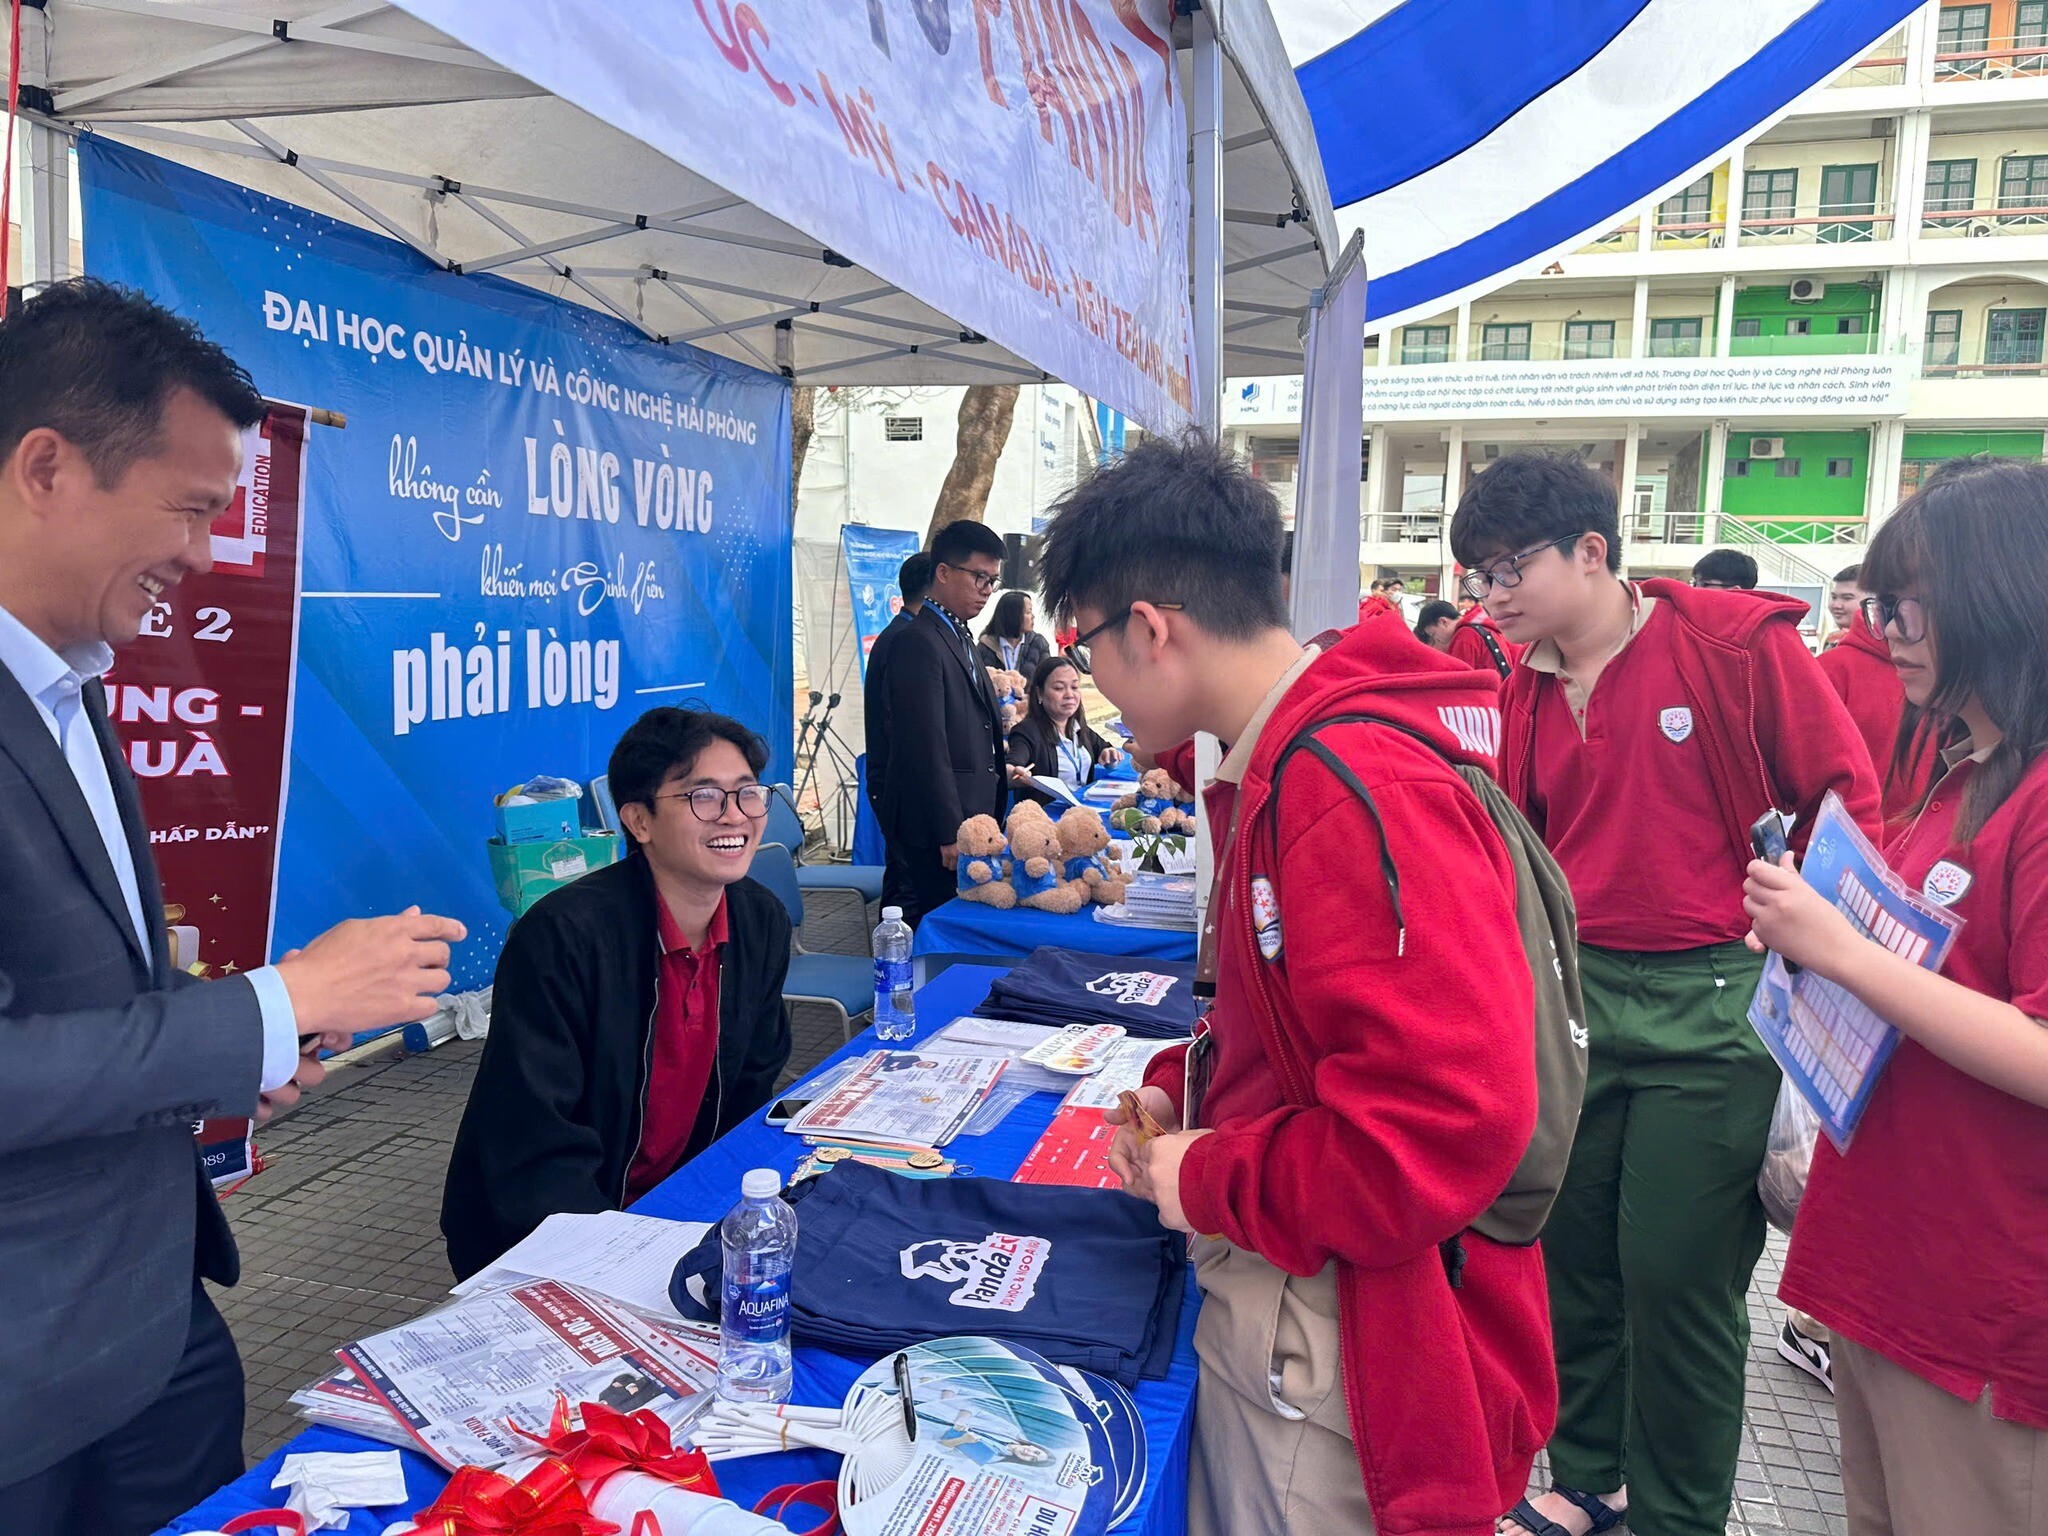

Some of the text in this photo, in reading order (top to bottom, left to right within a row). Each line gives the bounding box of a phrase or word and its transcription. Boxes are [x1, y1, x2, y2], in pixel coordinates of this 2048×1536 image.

[816, 68, 906, 194] MỸ
[927, 160, 1061, 308] CANADA
[1069, 265, 1111, 345] NEW
[1111, 304, 1163, 388] ZEALAND
[263, 290, 757, 445] ĐẠI HỌC QUẢN LÝ VÀ CÔNG NGHỆ HẢI PHÒNG
[1380, 377, 1389, 385] và
[1391, 377, 1409, 386] sáng
[1428, 375, 1443, 383] kiến
[1445, 375, 1462, 383] thức
[1502, 373, 1517, 381] tính
[1519, 373, 1539, 381] nhân
[1558, 372, 1568, 380] và
[1592, 371, 1618, 379] nhiệm
[1662, 369, 1690, 378] Trường
[1693, 369, 1708, 377] Đại
[1710, 369, 1725, 377] học
[1727, 369, 1751, 377] Quản
[1775, 368, 1797, 377] Công
[1799, 368, 1821, 377] nghệ
[1824, 367, 1839, 375] Hải
[1841, 367, 1870, 376] Phòng
[1872, 366, 1892, 374] luôn
[1378, 402, 1398, 410] năng
[1400, 402, 1410, 410] lực
[1428, 401, 1450, 409] người
[1452, 401, 1471, 409] công
[1528, 398, 1545, 406] hiểu
[1547, 398, 1556, 406] rõ
[1557, 398, 1573, 406] bản
[1615, 397, 1630, 405] chủ
[1644, 397, 1654, 405] sử
[1656, 397, 1677, 405] dụng
[1680, 397, 1700, 405] sáng
[1703, 396, 1717, 404] tạo
[1760, 396, 1781, 404] phục
[1796, 395, 1817, 404] cộng
[1820, 395, 1841, 404] đồng
[1389, 390, 1408, 398] cung
[1410, 388, 1425, 397] cấp
[1438, 388, 1451, 396] hội
[1452, 388, 1466, 396] học
[1468, 388, 1482, 396] tập
[1484, 387, 1493, 395] có
[1495, 386, 1513, 395] chất
[1515, 386, 1538, 395] lượng
[1554, 385, 1574, 393] nhất
[1576, 385, 1594, 394] giúp
[1596, 384, 1613, 392] sinh
[1635, 383, 1655, 392] phát
[1658, 382, 1676, 391] triển
[1701, 383, 1720, 391] diện
[1769, 382, 1781, 390] lực
[1798, 381, 1820, 389] nhân
[466, 468, 503, 508] cần
[524, 419, 620, 525] LÒNG
[634, 443, 714, 534] VÒNG
[252, 454, 271, 536] EDUCATION
[481, 543, 665, 616] khiến mọi Sinh Viên
[193, 607, 233, 642] 2
[393, 621, 620, 735] phải lòng
[121, 729, 231, 778] UÀ
[150, 825, 199, 843] HẤP
[738, 1292, 790, 1317] AQUAFINA
[462, 1416, 488, 1440] PANDA
[482, 1432, 505, 1451] HỌC
[496, 1446, 515, 1458] DU
[939, 1479, 961, 1506] Hotline:
[1022, 1506, 1059, 1536] DU HỌ
